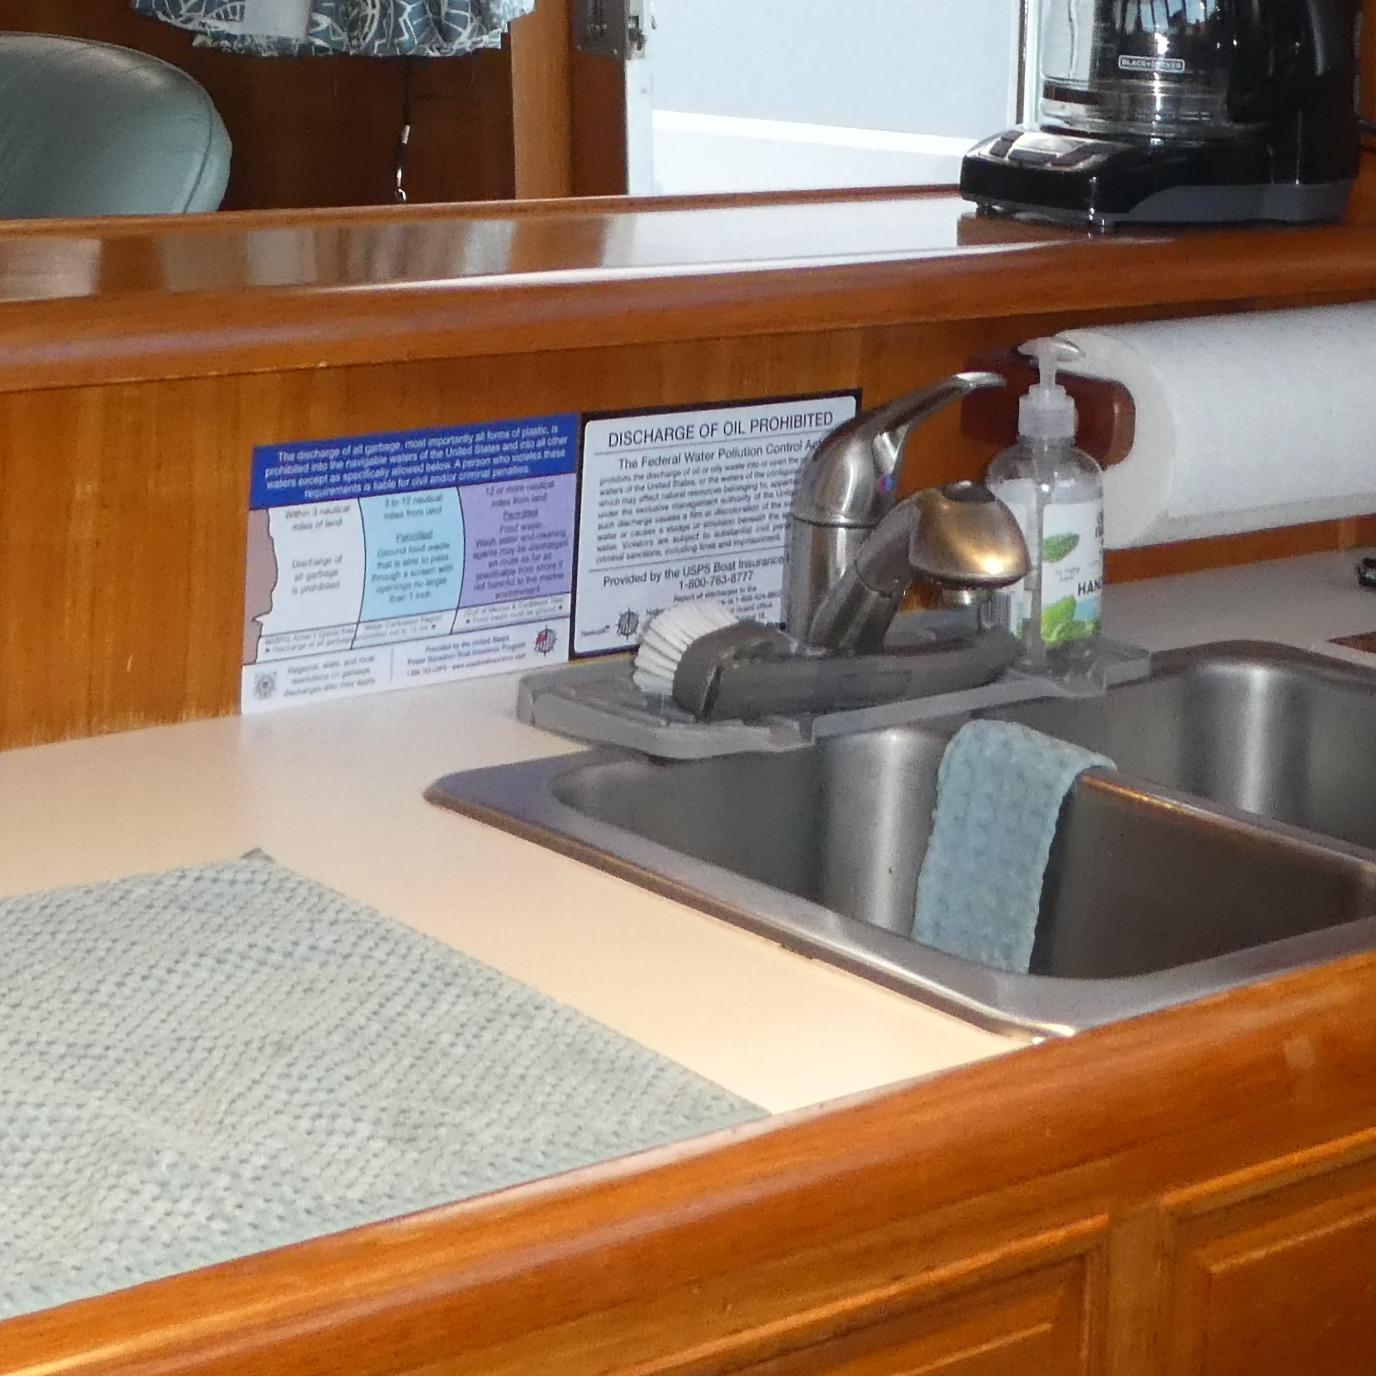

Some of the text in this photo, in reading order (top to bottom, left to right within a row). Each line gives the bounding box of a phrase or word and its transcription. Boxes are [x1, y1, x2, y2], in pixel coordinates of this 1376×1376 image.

[608, 424, 695, 448] DISCHARGE
[723, 420, 746, 436] OIL
[750, 411, 834, 434] PROHIBITED
[279, 452, 295, 463] The
[618, 457, 638, 470] The
[642, 452, 681, 468] Federal
[684, 449, 715, 463] Water
[718, 444, 763, 460] Pollution
[766, 440, 802, 454] Control
[603, 571, 647, 587] Provided
[665, 567, 680, 579] the
[683, 563, 711, 577] USPS
[714, 560, 736, 573] Boat
[679, 570, 754, 591] 1-800-763-8777
